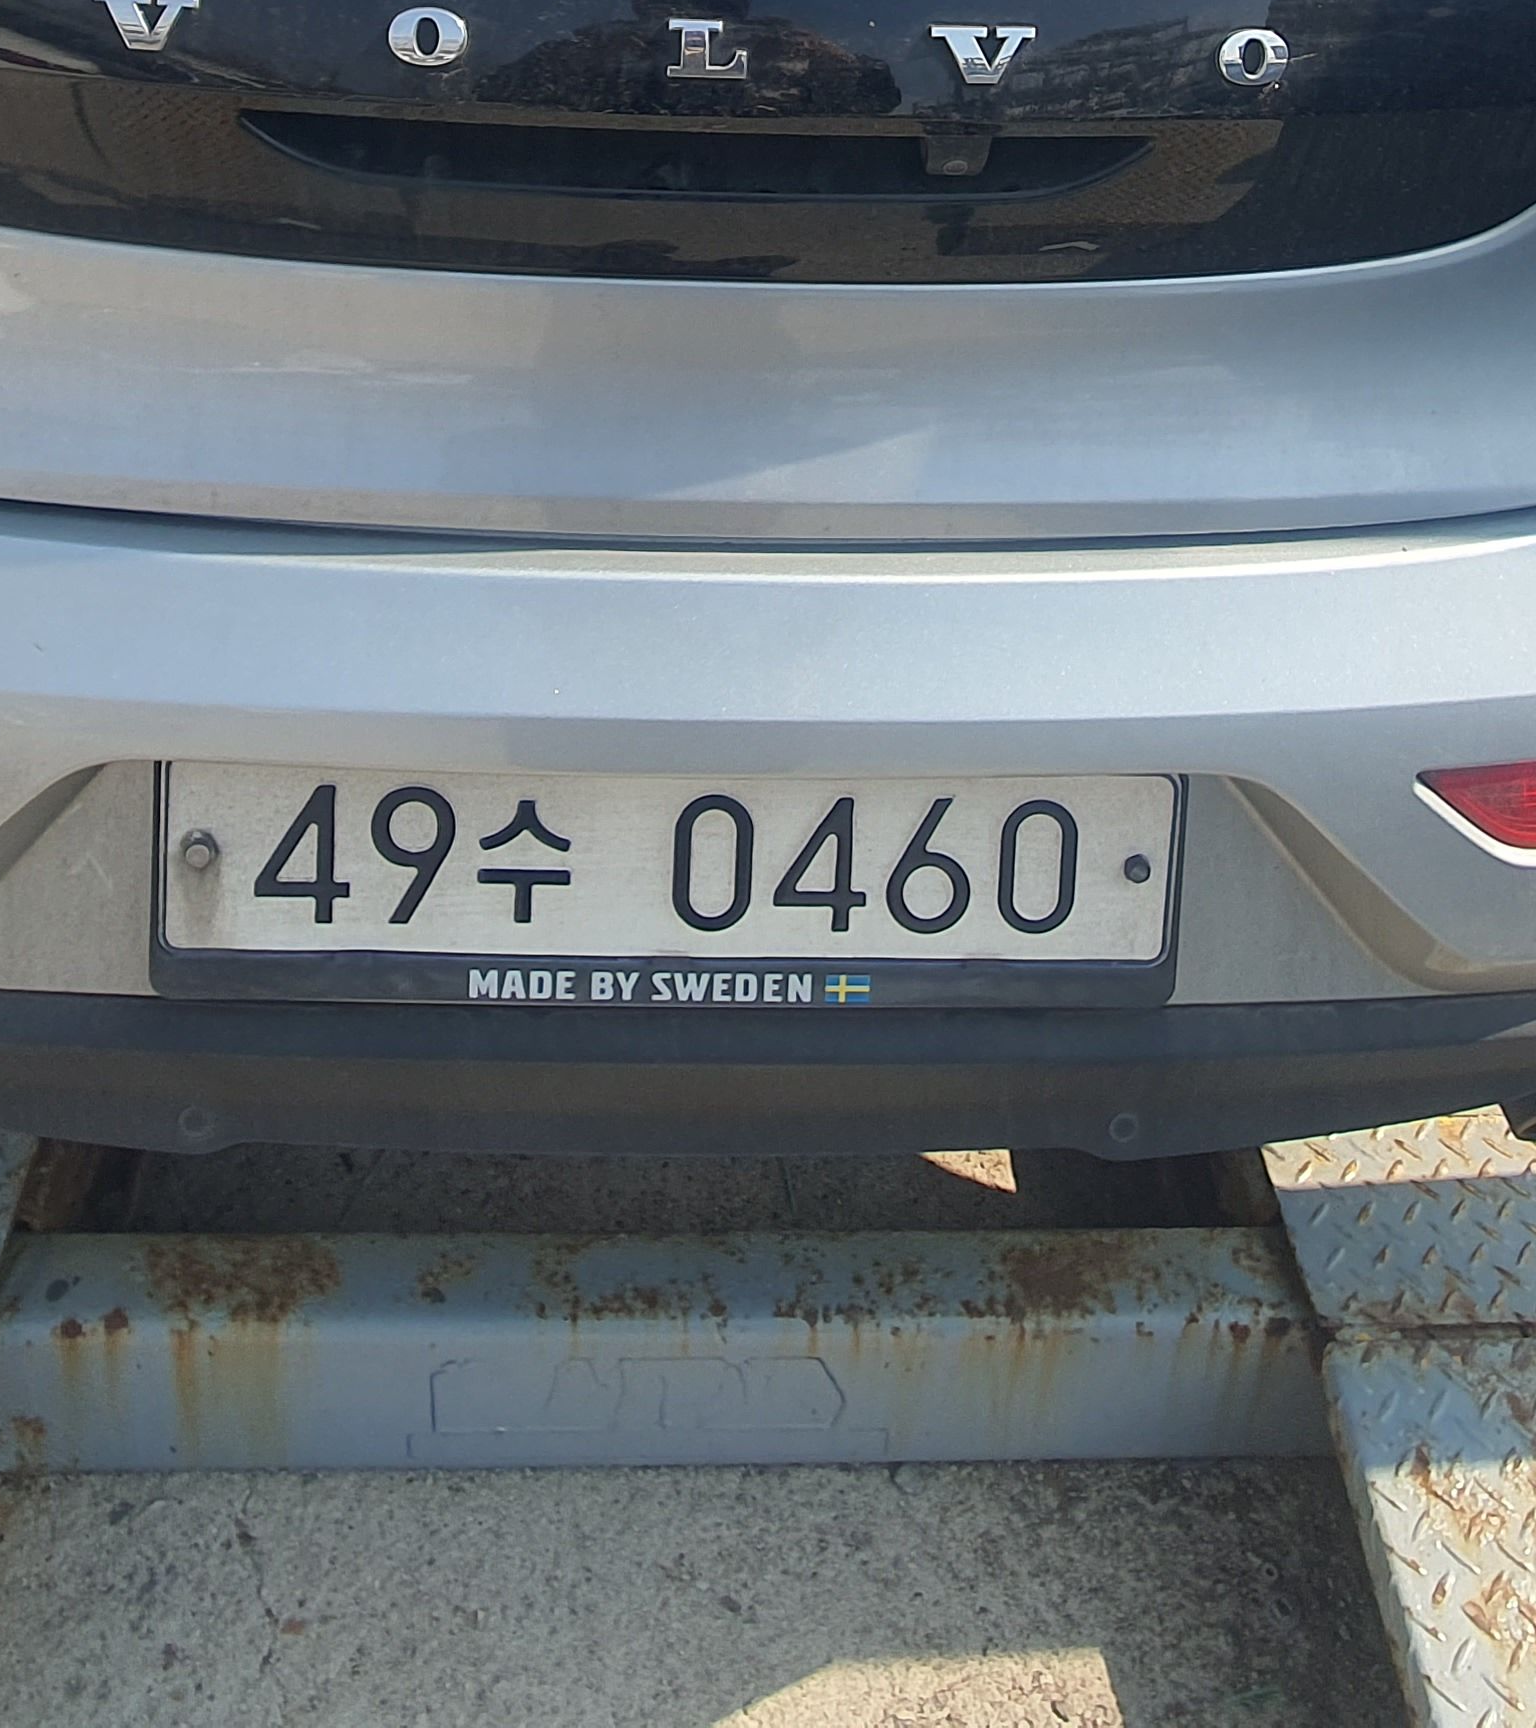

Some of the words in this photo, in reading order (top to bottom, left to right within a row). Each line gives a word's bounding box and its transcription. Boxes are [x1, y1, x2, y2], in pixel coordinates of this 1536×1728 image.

[253, 784, 571, 925] 49수
[671, 793, 1080, 934] 0460
[468, 968, 577, 1001] MADE
[591, 969, 640, 1003] BY
[651, 971, 813, 1004] SWEDEN
